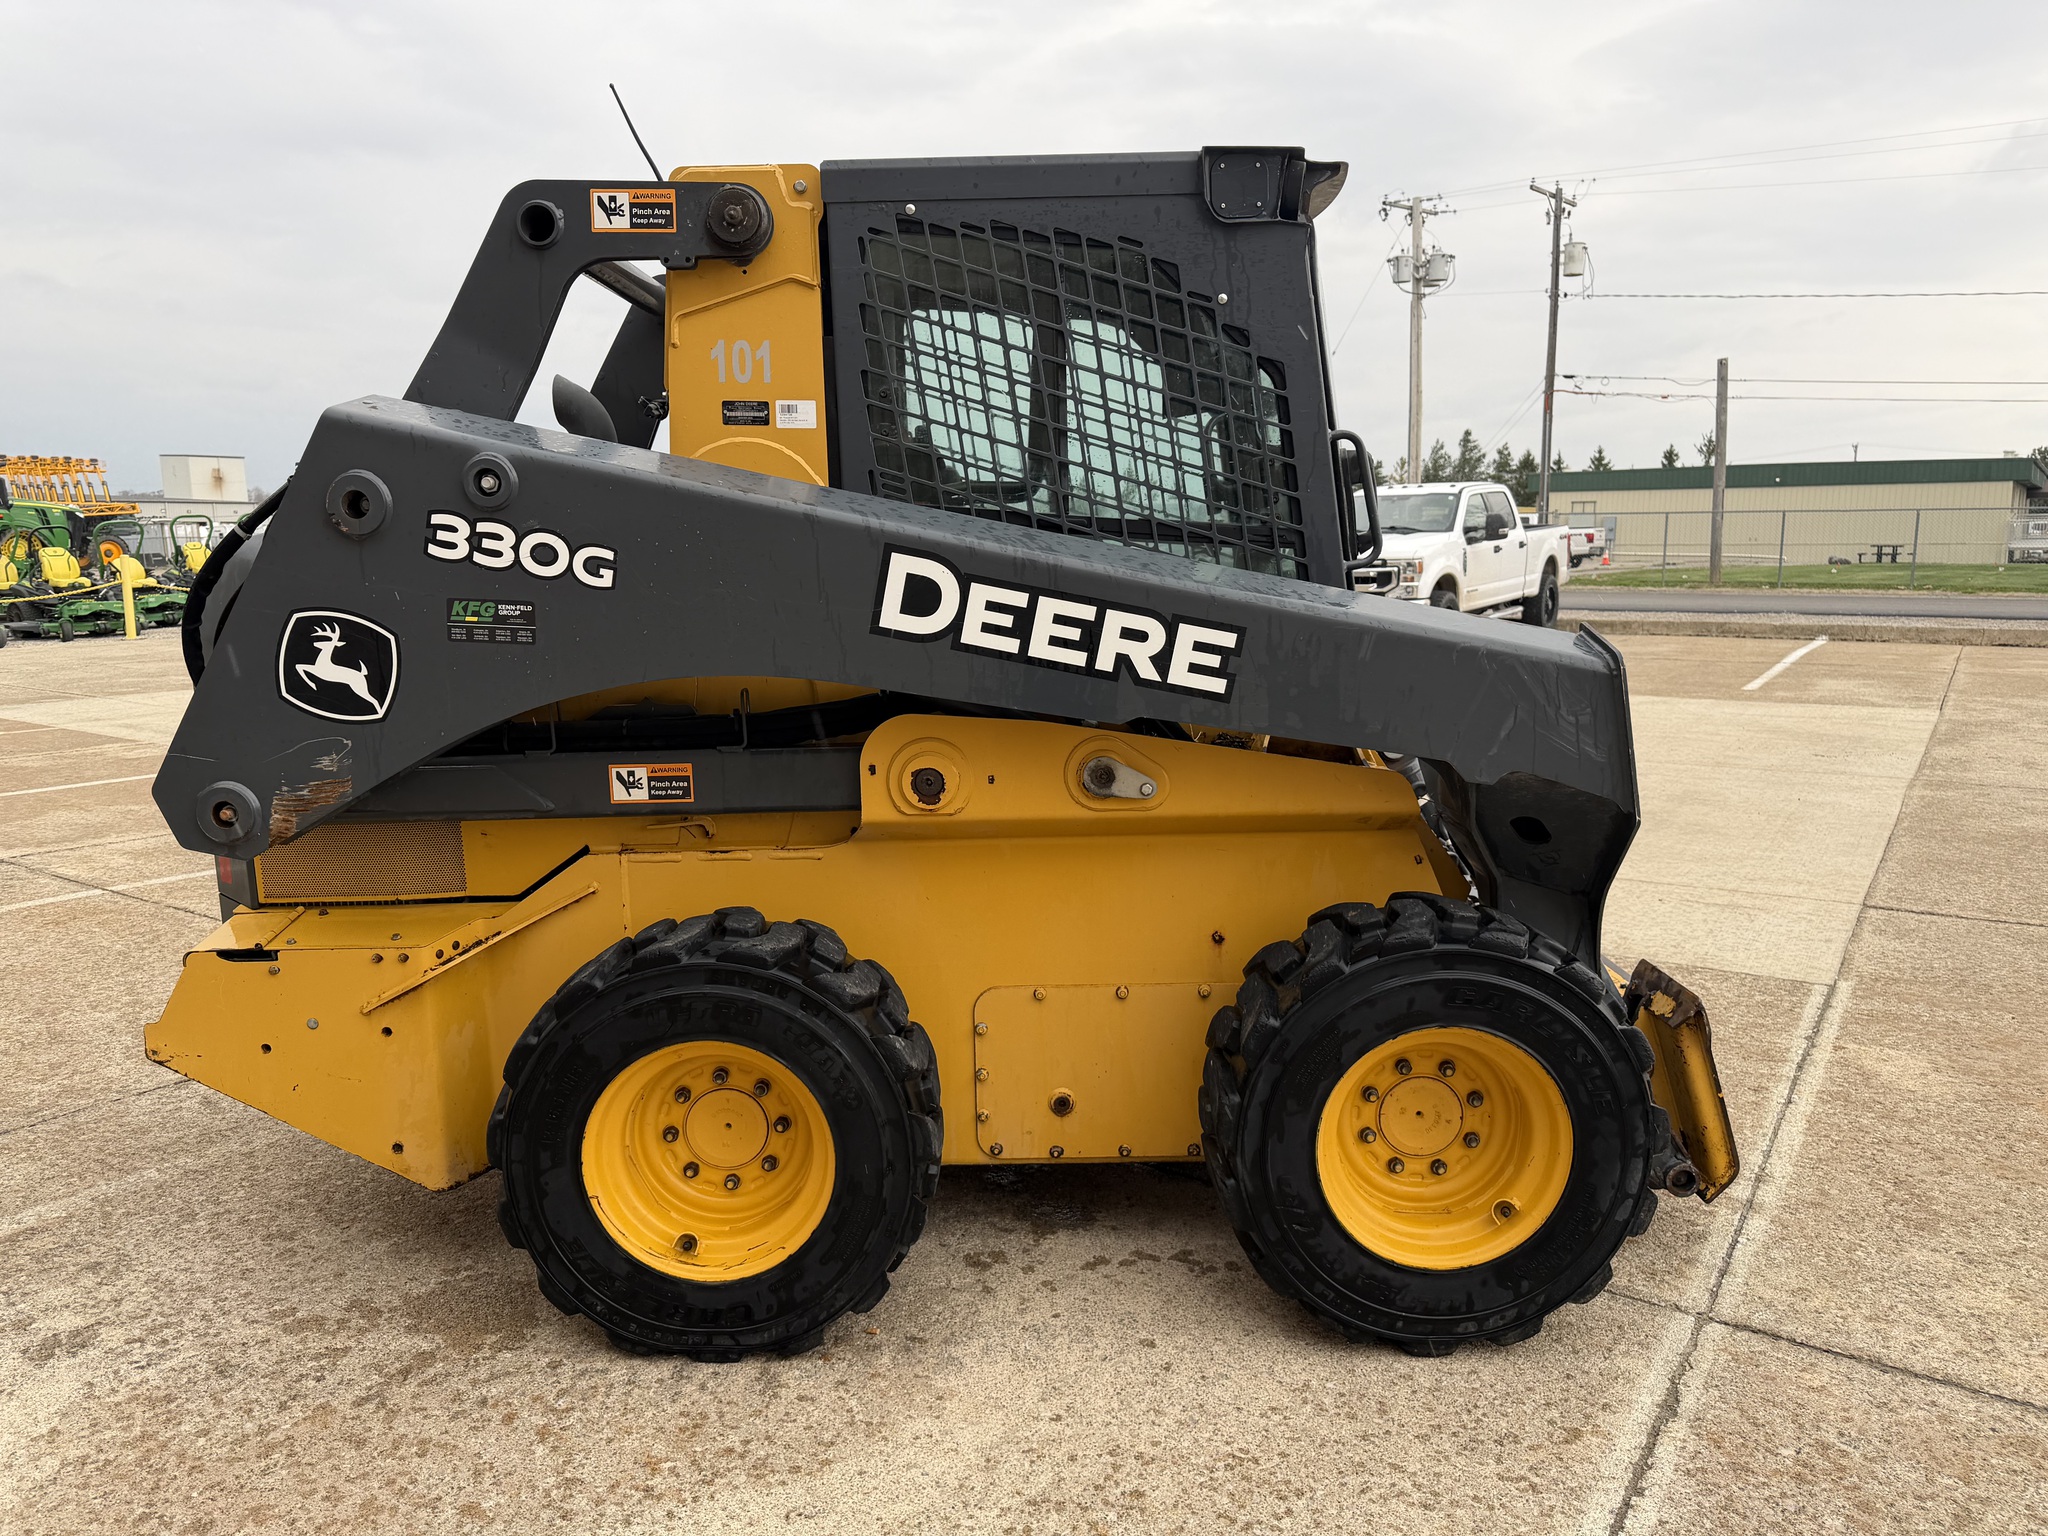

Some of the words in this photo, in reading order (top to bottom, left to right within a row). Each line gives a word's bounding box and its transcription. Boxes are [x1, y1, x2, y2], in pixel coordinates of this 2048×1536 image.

[632, 217, 648, 225] Keep
[649, 217, 666, 225] Away
[710, 339, 772, 384] 101
[427, 513, 615, 588] 330G
[451, 600, 496, 617] KFG
[878, 551, 1238, 695] DEERE
[1446, 983, 1617, 1117] CARLISLE
